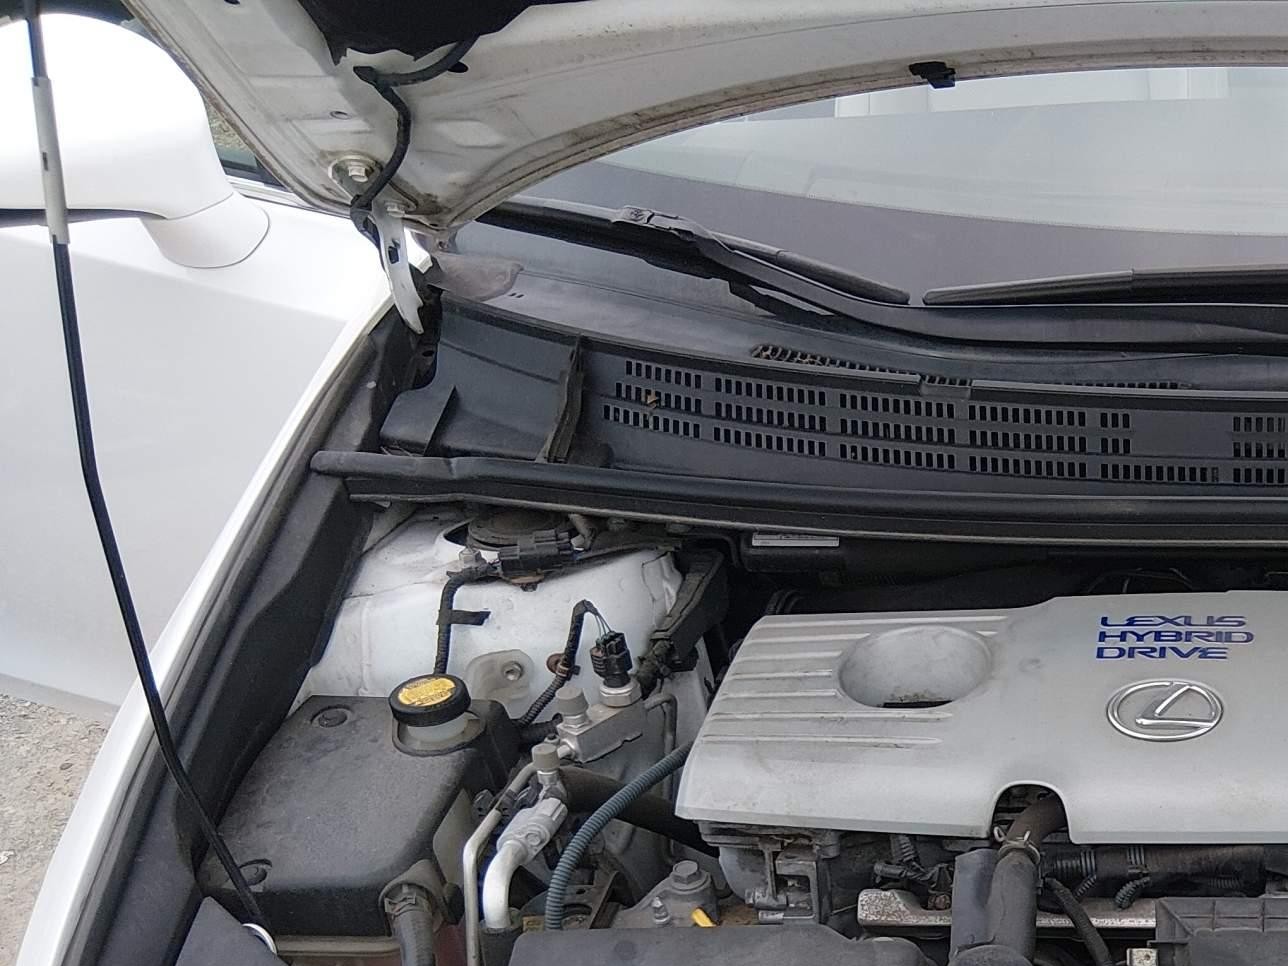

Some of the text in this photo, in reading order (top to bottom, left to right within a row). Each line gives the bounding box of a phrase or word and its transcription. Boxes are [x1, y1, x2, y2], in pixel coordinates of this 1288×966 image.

[1100, 615, 1247, 628] LEXUS
[1097, 630, 1255, 643] HYBRID
[1095, 646, 1229, 659] DRIVE
